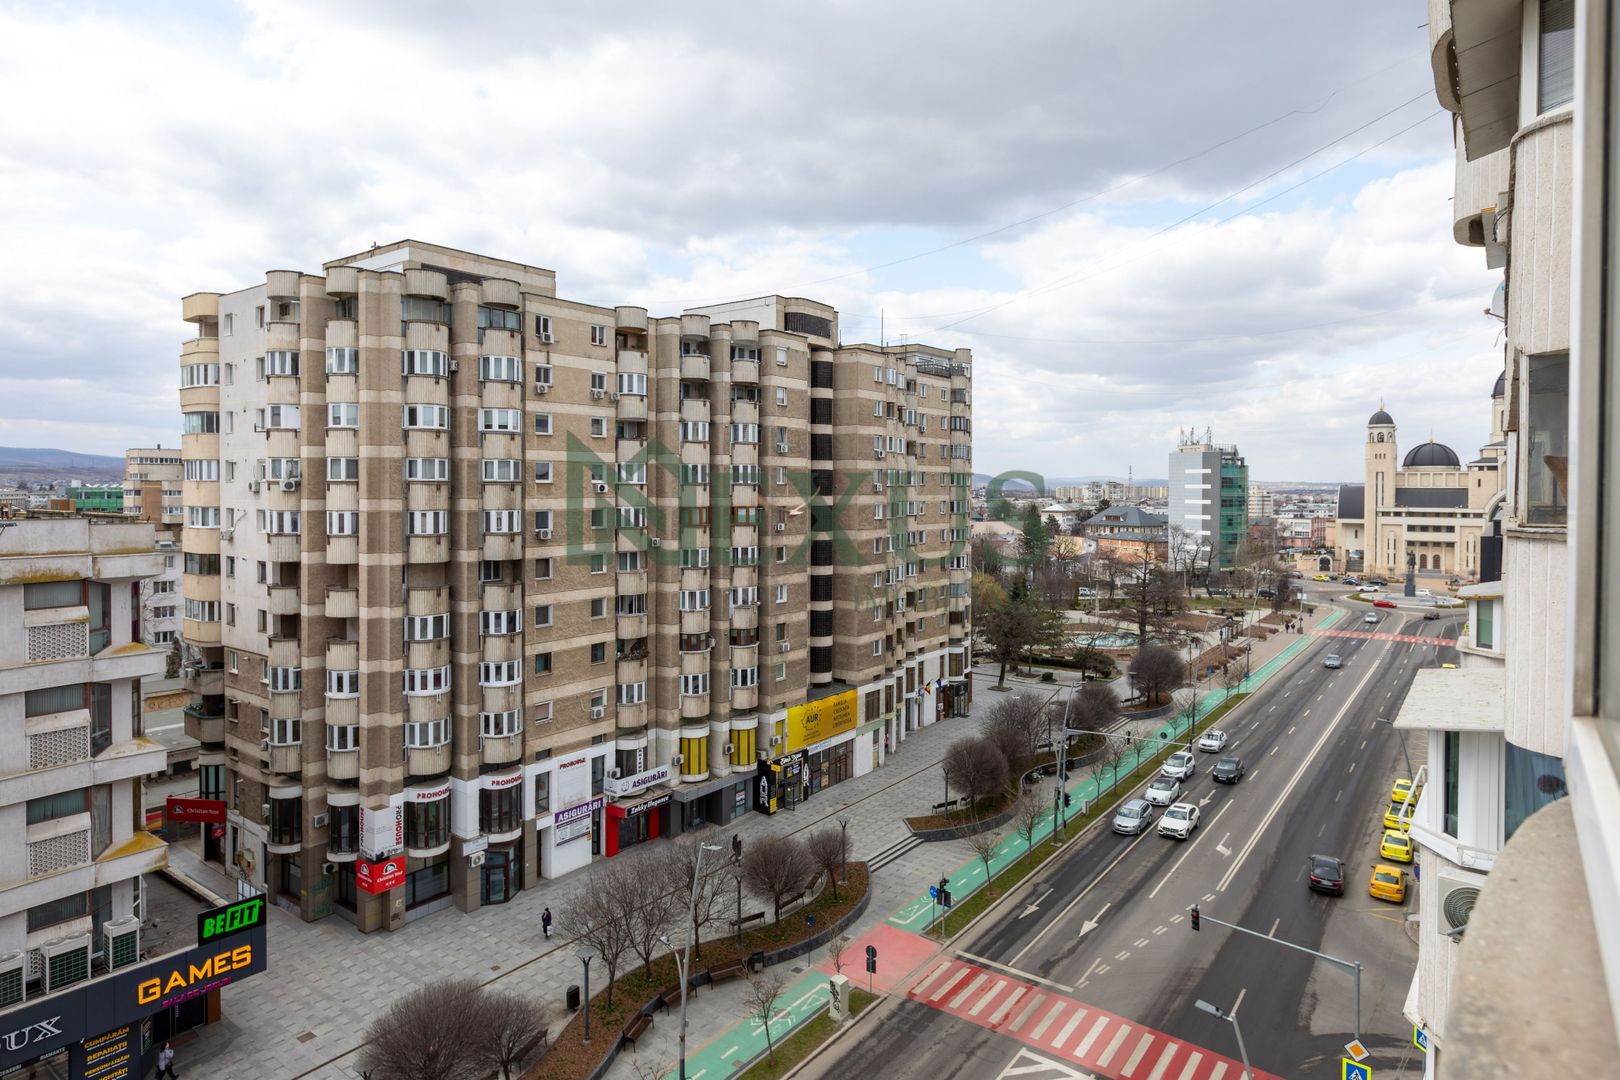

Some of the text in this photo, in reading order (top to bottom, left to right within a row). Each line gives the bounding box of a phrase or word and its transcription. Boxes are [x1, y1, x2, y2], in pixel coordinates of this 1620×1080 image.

[806, 713, 819, 723] AUR
[138, 945, 252, 1005] GAMES
[0, 1015, 63, 1052] UX
